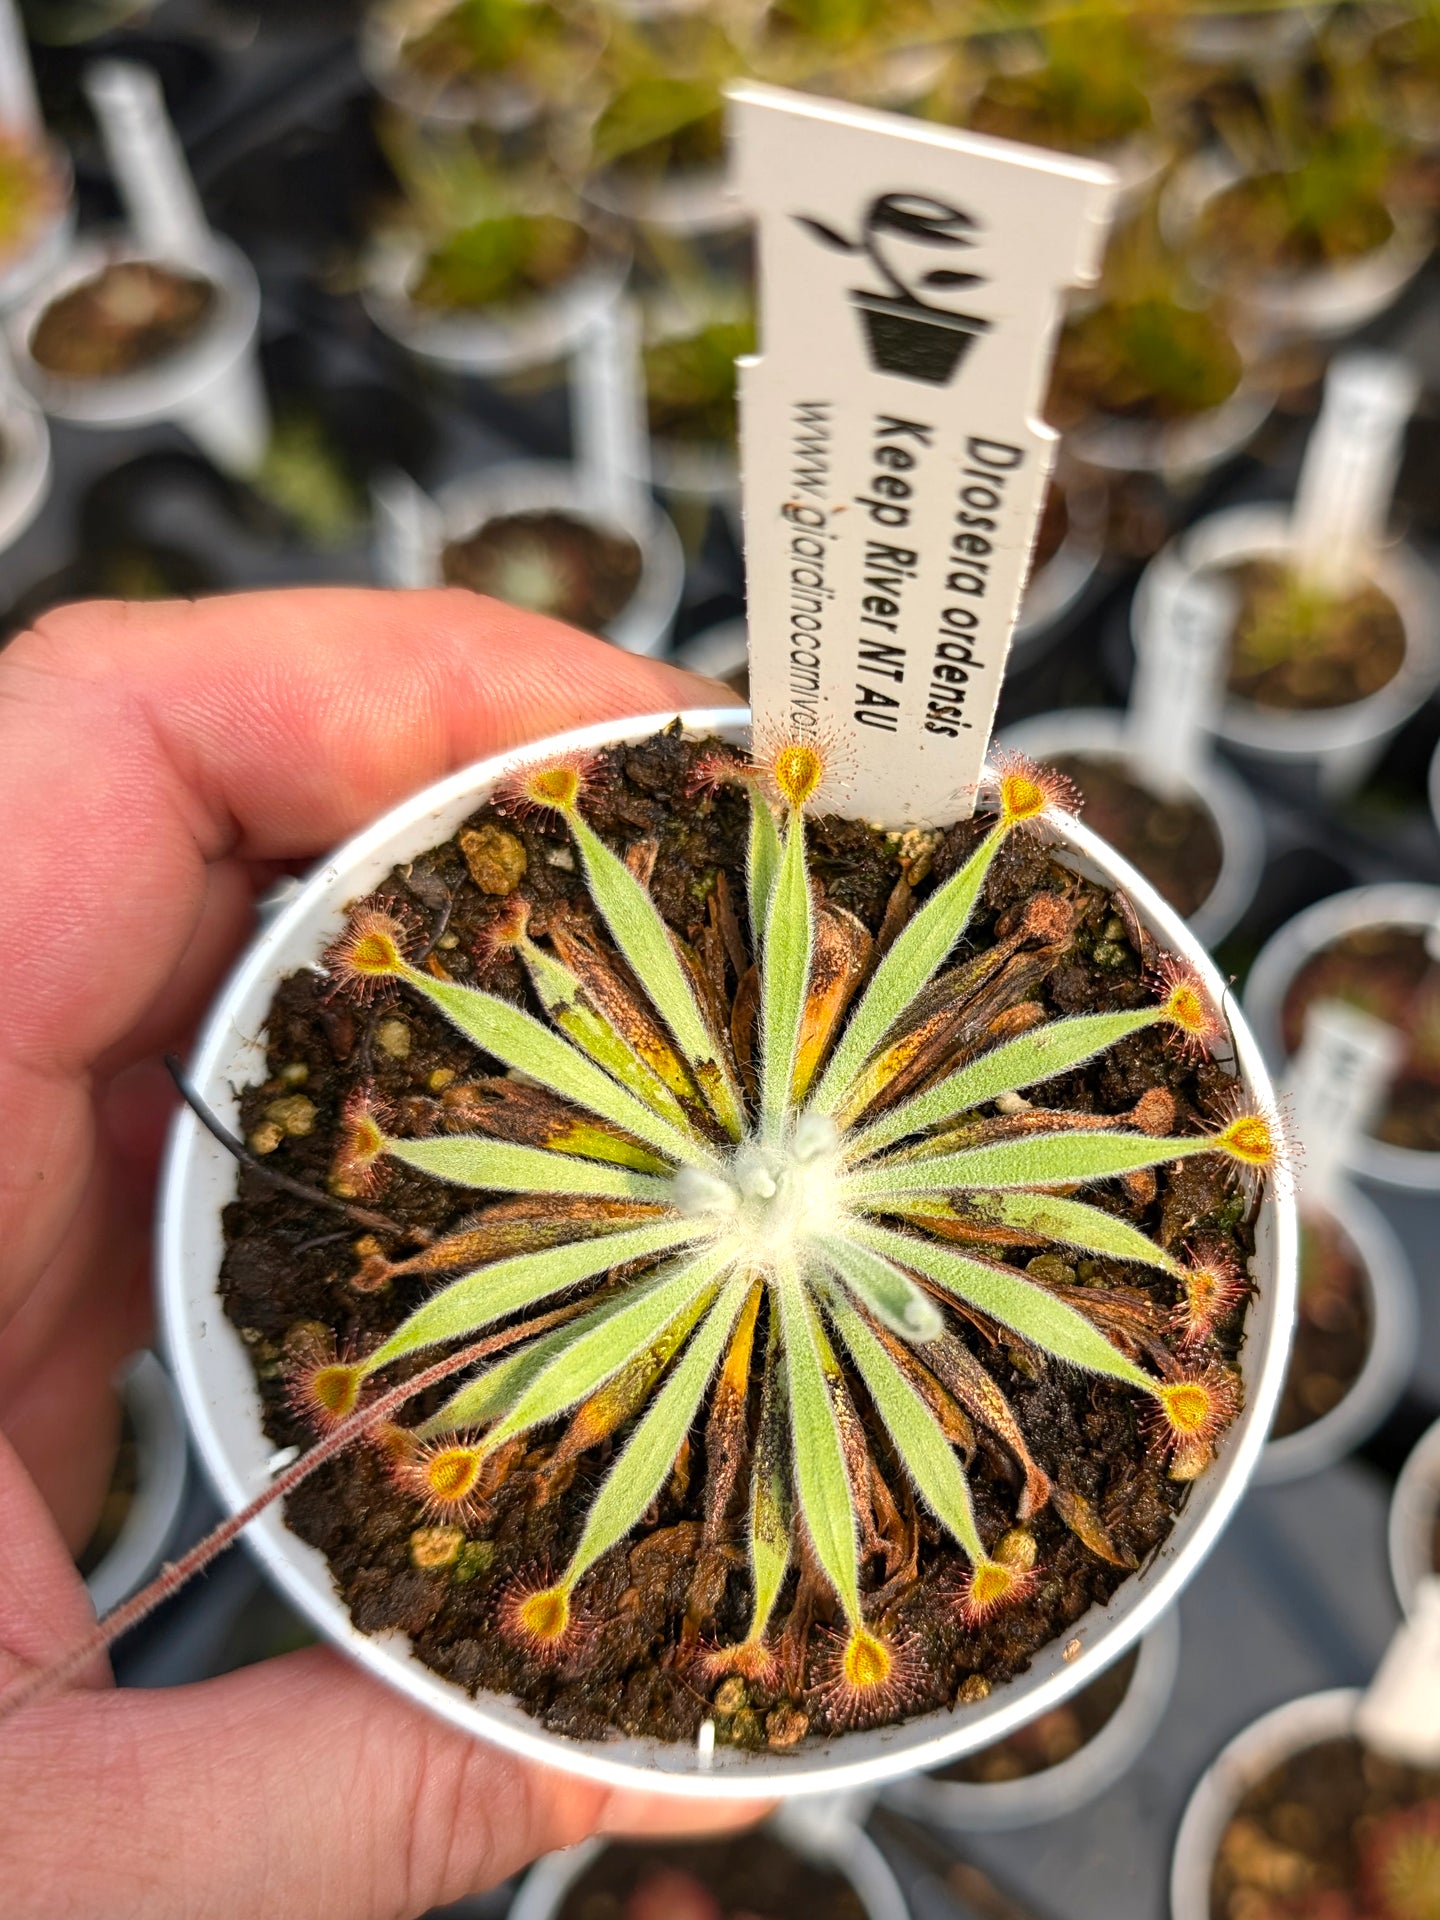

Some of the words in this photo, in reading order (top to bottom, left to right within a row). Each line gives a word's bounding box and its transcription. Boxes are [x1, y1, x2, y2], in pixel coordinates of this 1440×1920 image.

[855, 414, 936, 528] Keep
[946, 436, 1025, 598] Drosera
[859, 541, 918, 631] River
[854, 683, 900, 732] AU
[857, 639, 907, 682] NT
[924, 608, 985, 739] ordensis
